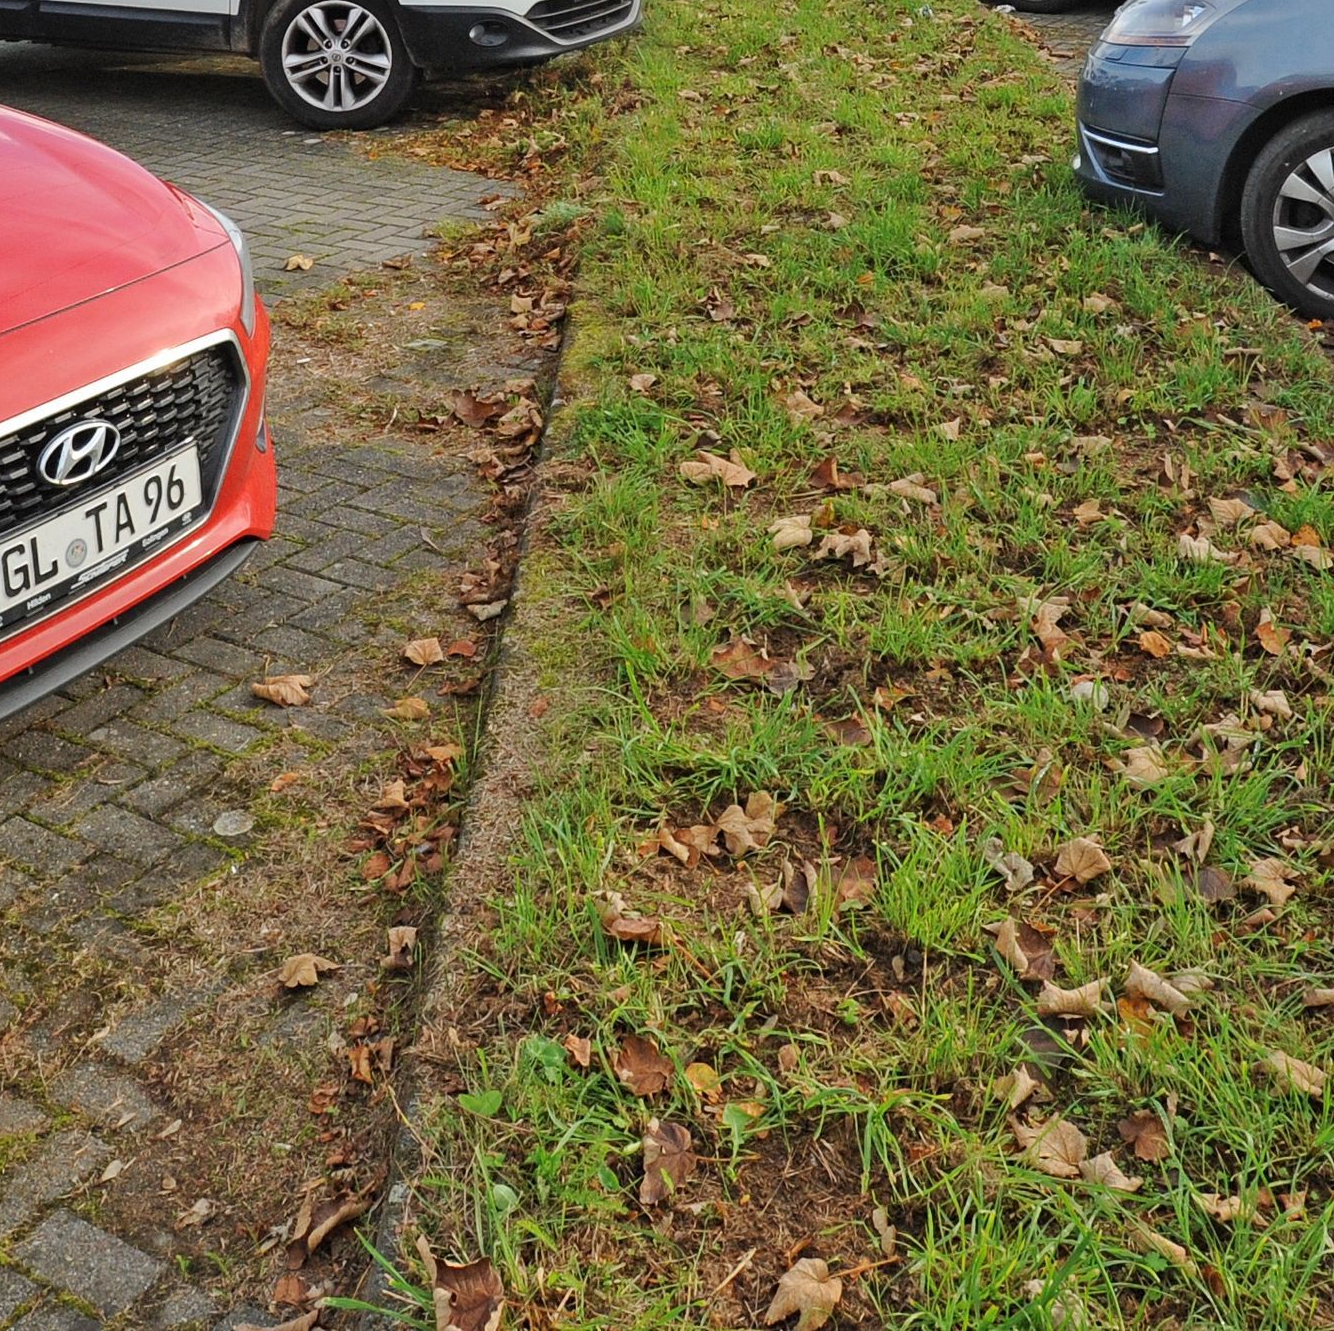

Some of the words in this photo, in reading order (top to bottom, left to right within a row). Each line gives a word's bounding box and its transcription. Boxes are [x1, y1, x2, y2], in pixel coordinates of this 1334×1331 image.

[1, 536, 59, 598] GL
[85, 491, 136, 554] TA
[143, 464, 184, 525] 96
